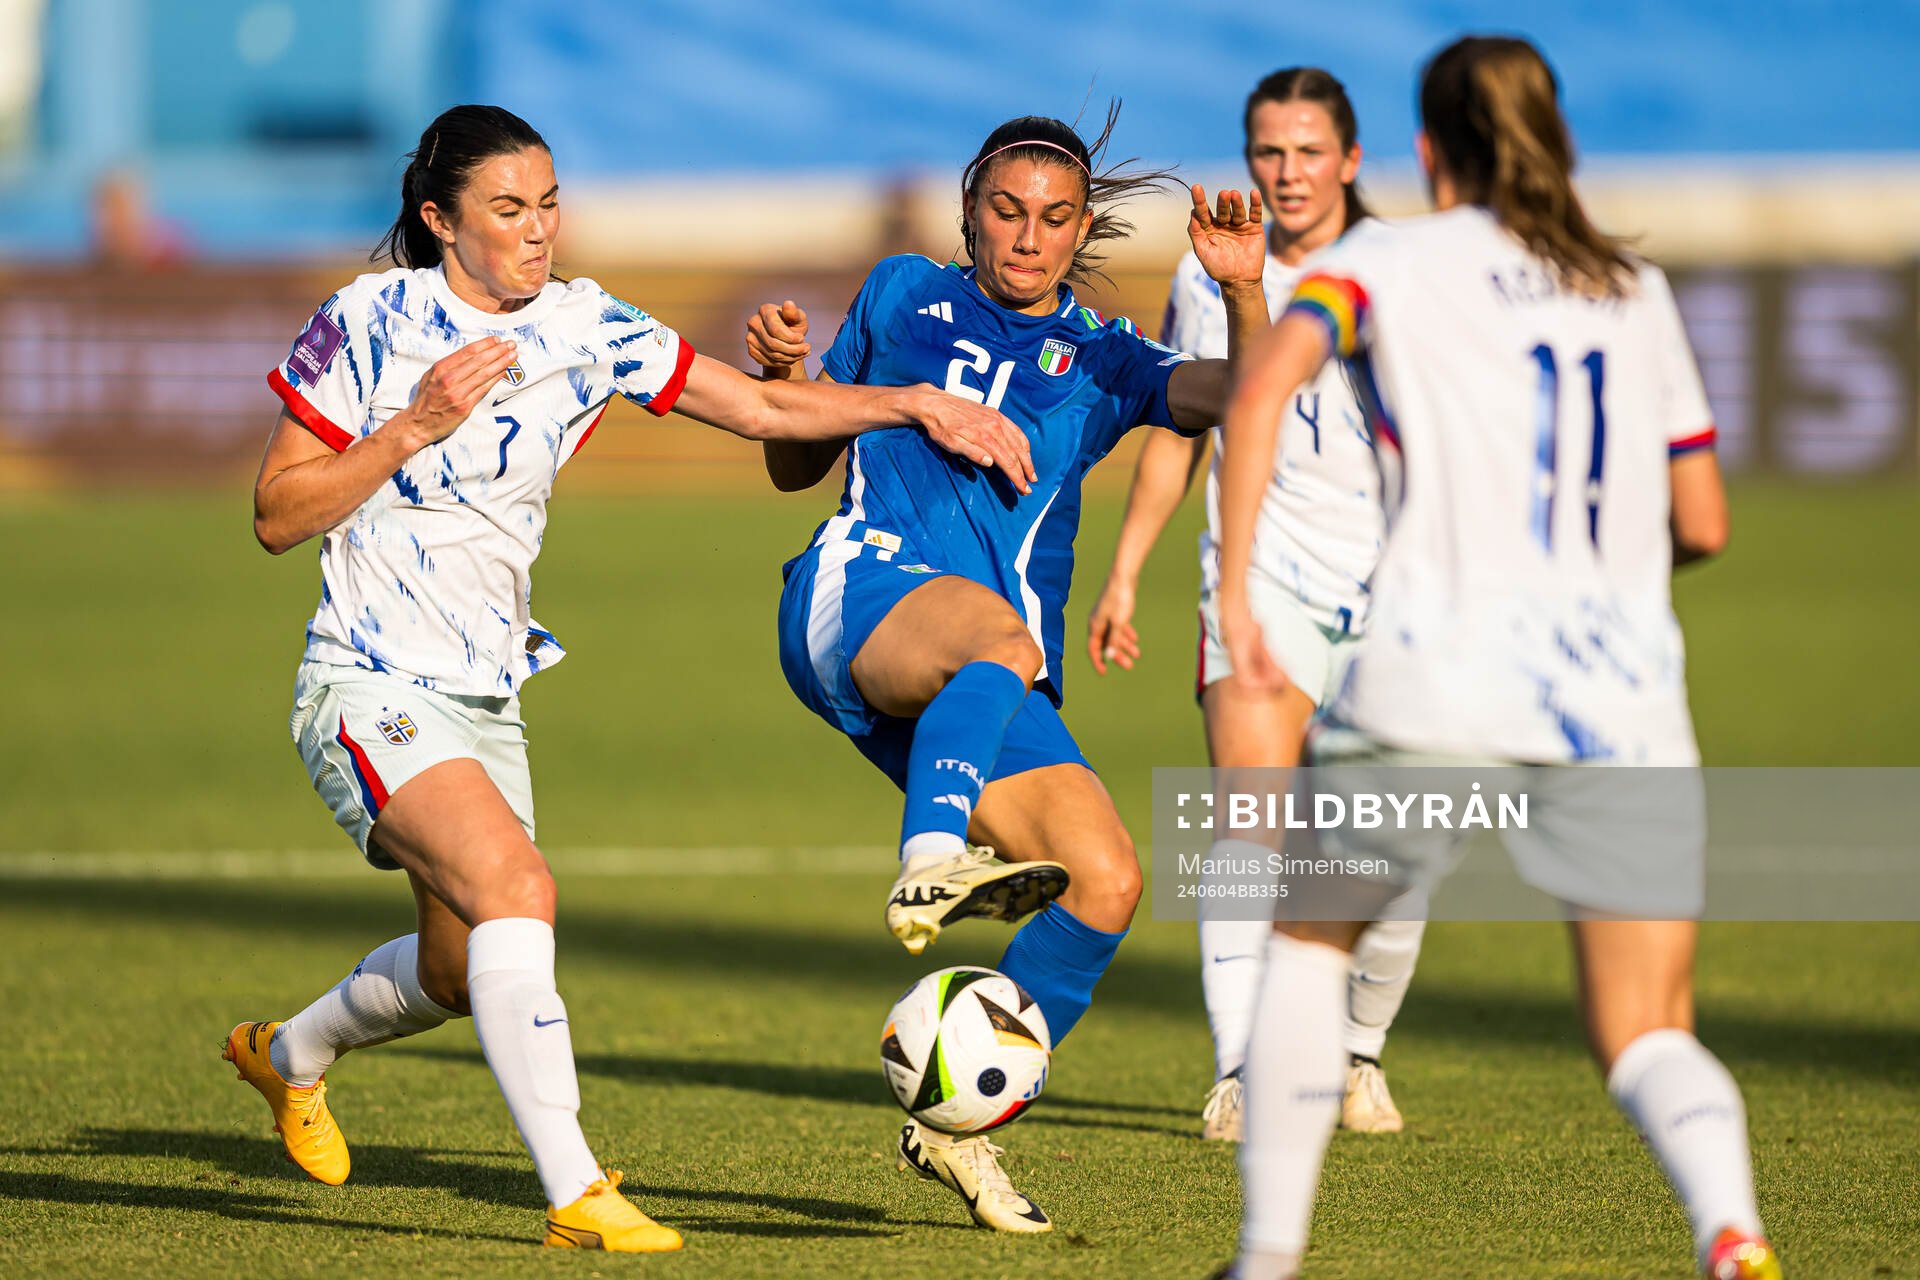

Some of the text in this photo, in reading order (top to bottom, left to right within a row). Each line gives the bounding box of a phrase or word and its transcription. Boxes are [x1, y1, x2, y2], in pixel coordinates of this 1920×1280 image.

[944, 339, 1016, 411] 21
[1046, 341, 1074, 355] ITALIA
[492, 415, 522, 481] 7
[1295, 393, 1321, 456] 4
[1530, 343, 1606, 557] 11
[935, 758, 985, 793] ITALI
